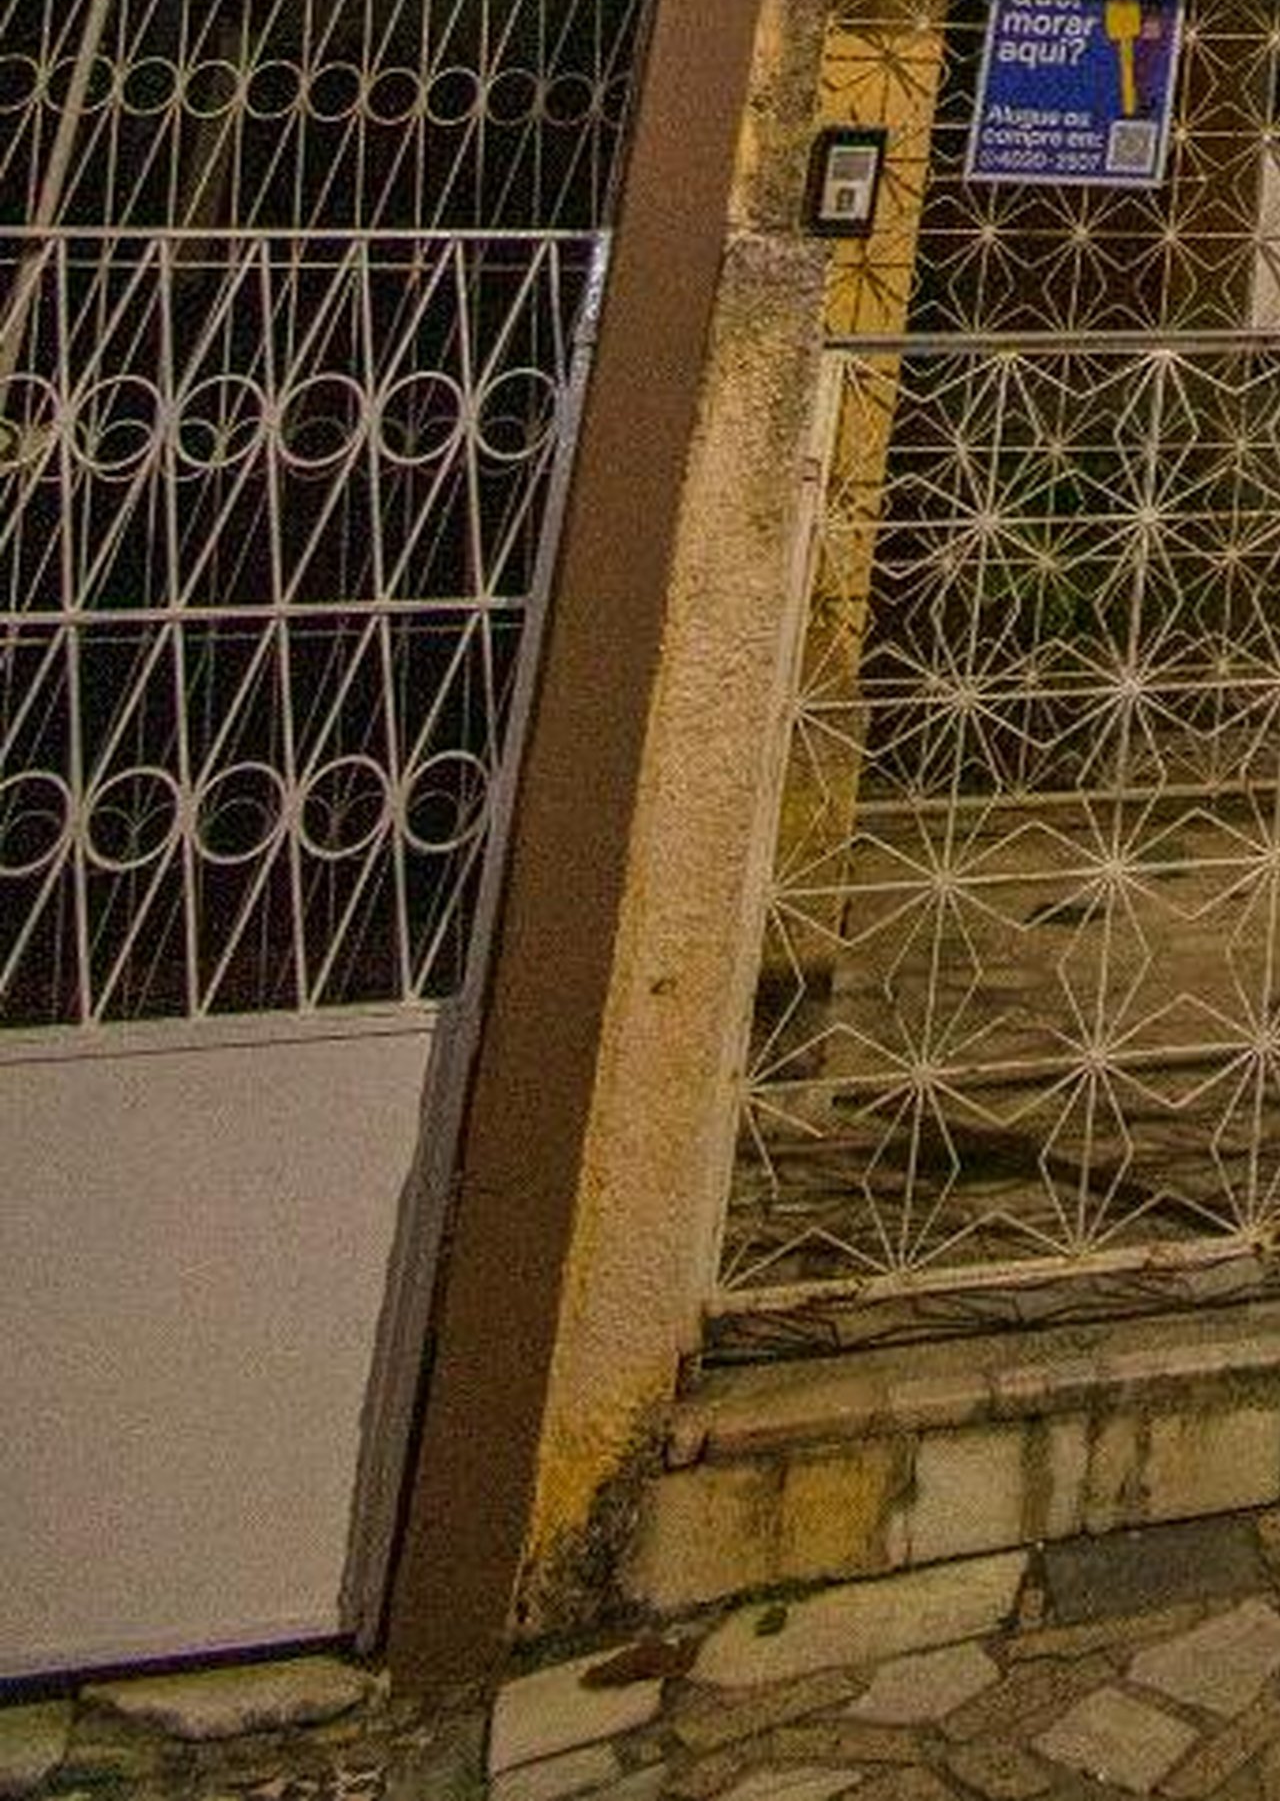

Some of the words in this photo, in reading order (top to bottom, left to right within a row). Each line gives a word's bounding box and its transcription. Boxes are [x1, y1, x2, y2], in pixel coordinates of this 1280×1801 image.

[1002, 11, 1098, 36] morar
[998, 39, 1087, 70] aqui?
[985, 105, 1060, 129] Alugue
[982, 128, 1062, 148] compre
